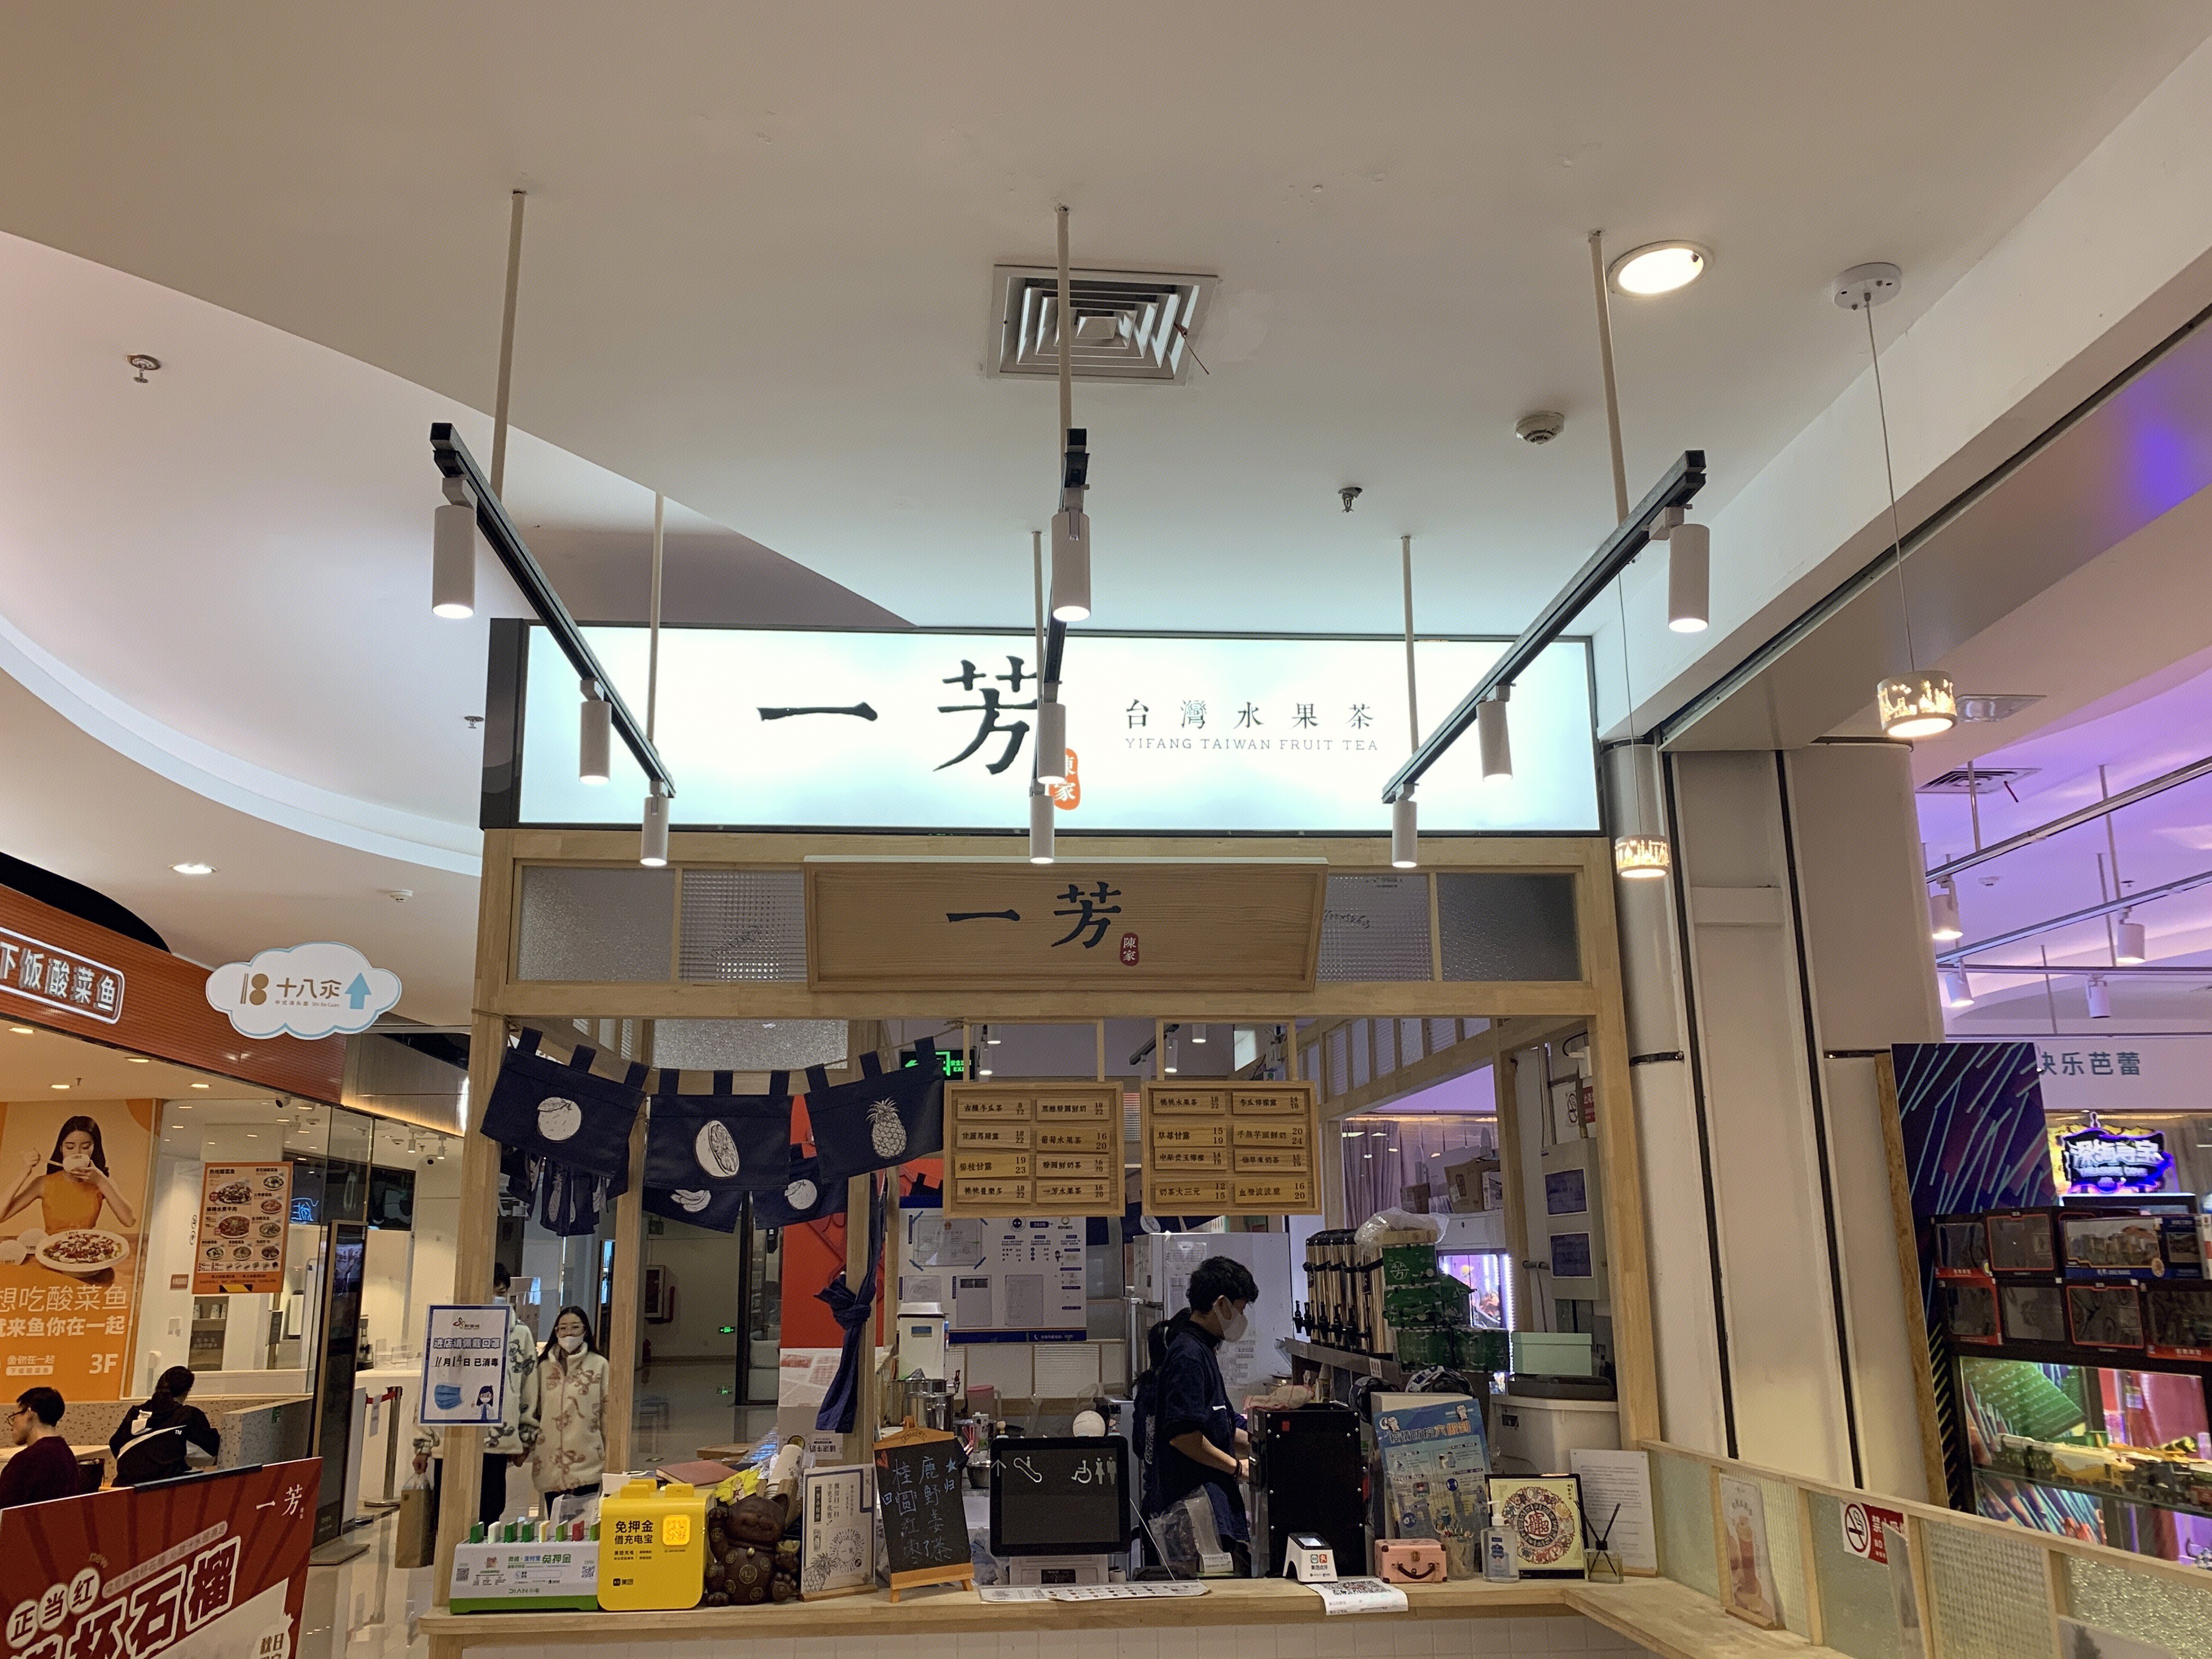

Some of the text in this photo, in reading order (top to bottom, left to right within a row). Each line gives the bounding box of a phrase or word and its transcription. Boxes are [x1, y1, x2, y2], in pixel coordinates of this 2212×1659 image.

[757, 656, 1037, 775] 一芳
[1126, 699, 1374, 729] 台灣水果茶
[1125, 738, 1378, 751] YIFANG TAIWAN FRUIT TEA
[946, 882, 1121, 947] 一芳
[0, 941, 115, 1011] 下饭酸菜鱼
[433, 1338, 501, 1349] 进店请佩戴口罩
[88, 1353, 119, 1374] 3F
[256, 1484, 302, 1516] 一芳
[615, 1520, 653, 1533] 免押金
[614, 1534, 653, 1544] 借充电宝
[542, 1554, 571, 1564] 免押金
